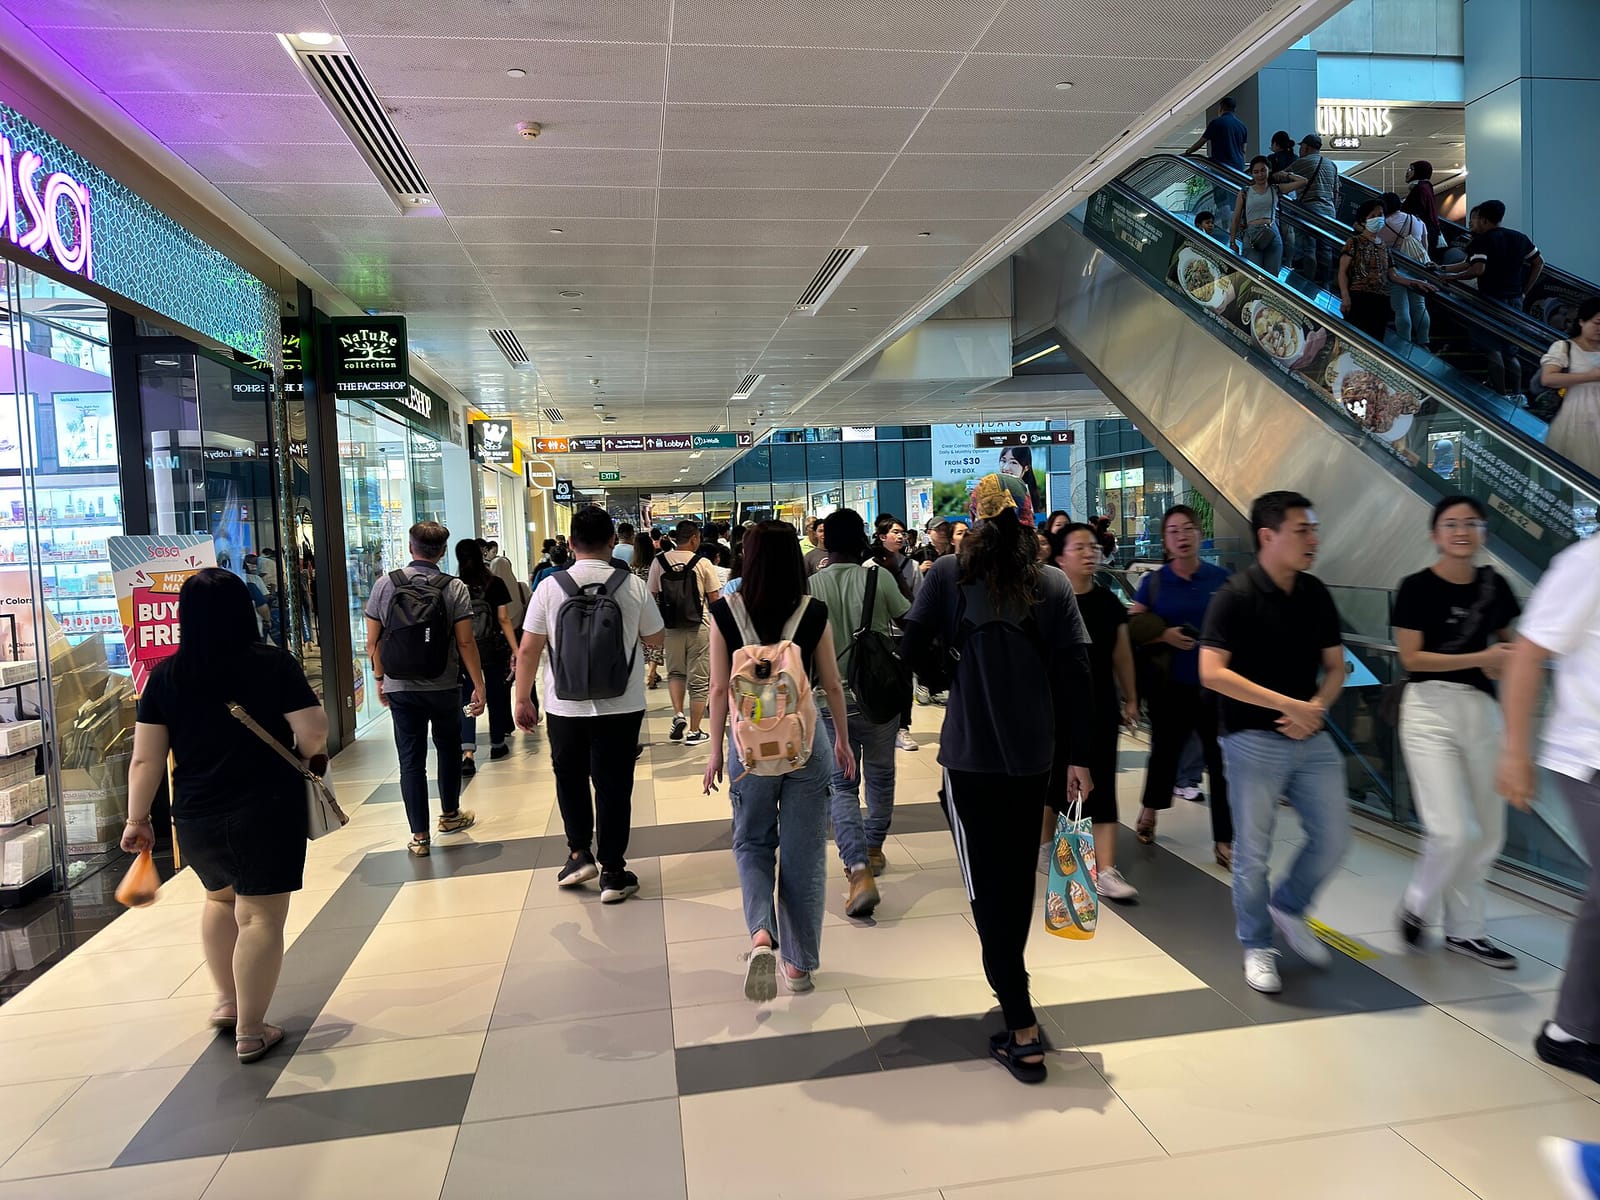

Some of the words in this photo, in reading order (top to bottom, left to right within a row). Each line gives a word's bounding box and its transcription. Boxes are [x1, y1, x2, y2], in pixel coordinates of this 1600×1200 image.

[1317, 107, 1342, 135] UN
[344, 361, 397, 369] collection
[739, 435, 750, 445] L2
[1058, 433, 1068, 441] L2
[664, 440, 684, 448] Lobby
[963, 457, 981, 465] $30
[164, 573, 184, 583] MIX
[162, 583, 181, 592] MA
[138, 601, 180, 622] BUY
[140, 623, 181, 648] FRE
